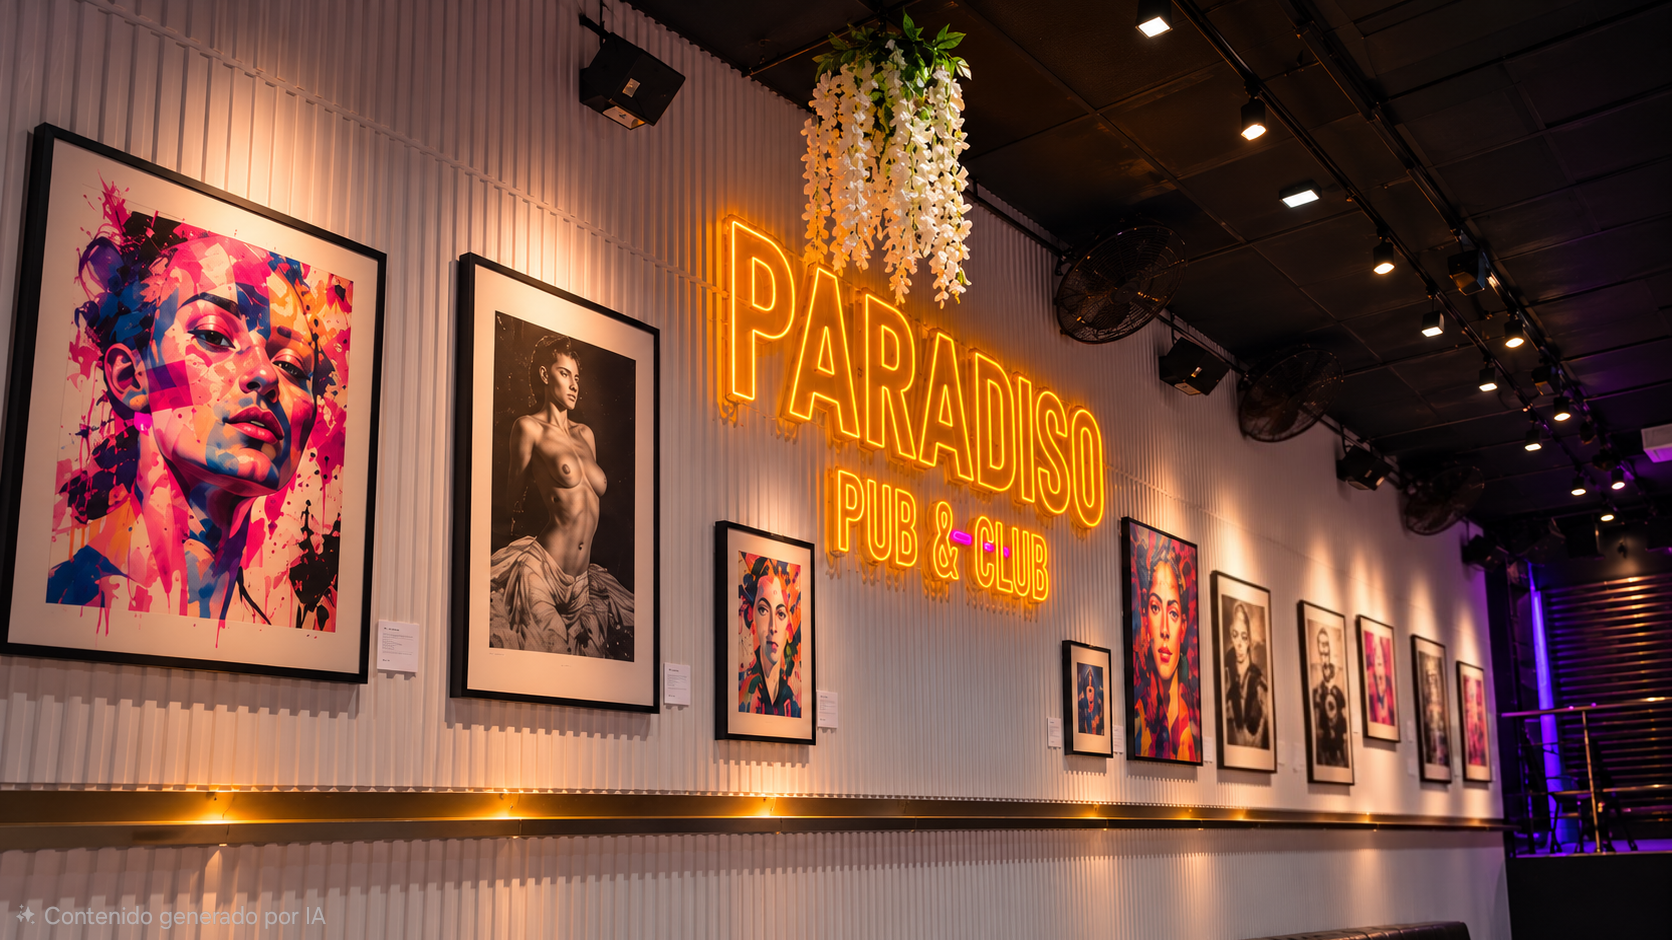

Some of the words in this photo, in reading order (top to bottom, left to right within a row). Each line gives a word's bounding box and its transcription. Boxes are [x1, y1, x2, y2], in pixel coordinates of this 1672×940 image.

[730, 219, 1105, 528] PARADISO
[837, 469, 919, 567] PUB
[932, 501, 960, 580] &
[974, 515, 1049, 602] CLUB
